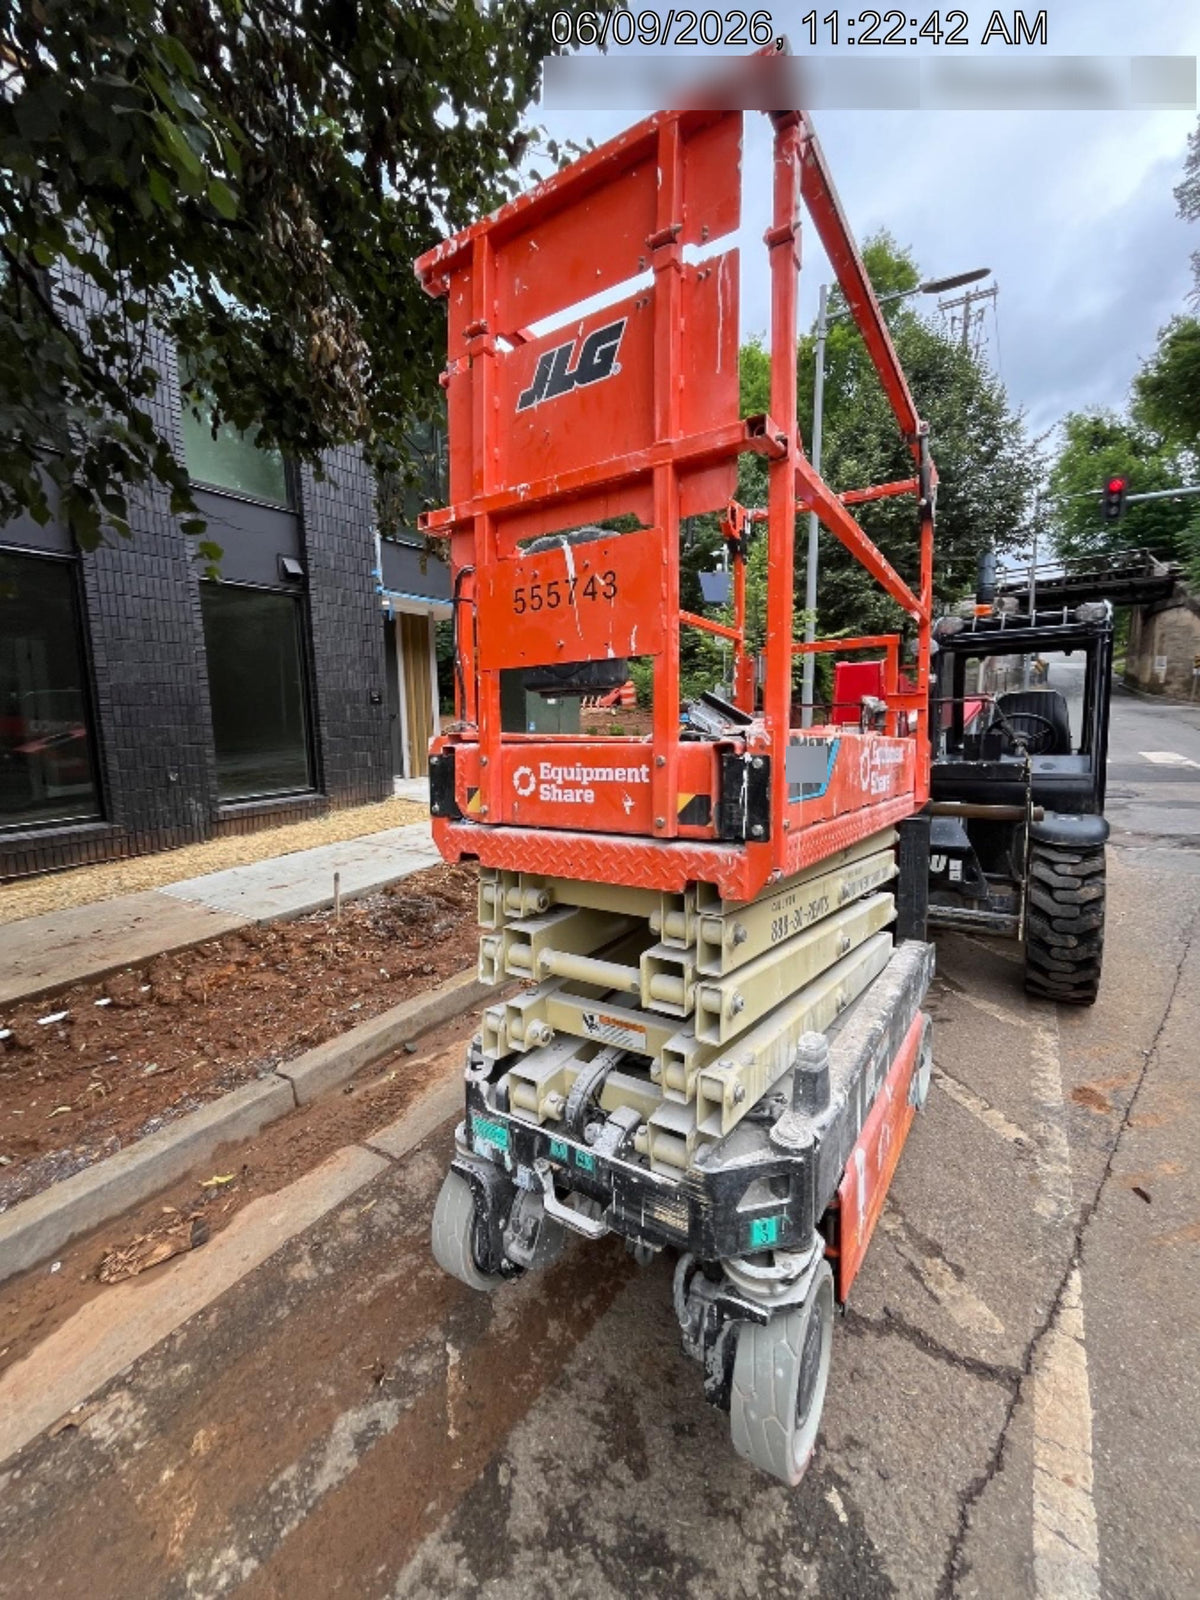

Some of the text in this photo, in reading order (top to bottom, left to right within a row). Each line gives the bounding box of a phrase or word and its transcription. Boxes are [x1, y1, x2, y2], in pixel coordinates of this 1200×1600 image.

[515, 317, 628, 413] JLG
[513, 571, 618, 614] 555743
[539, 762, 650, 785] Equipment
[539, 783, 595, 804] Share
